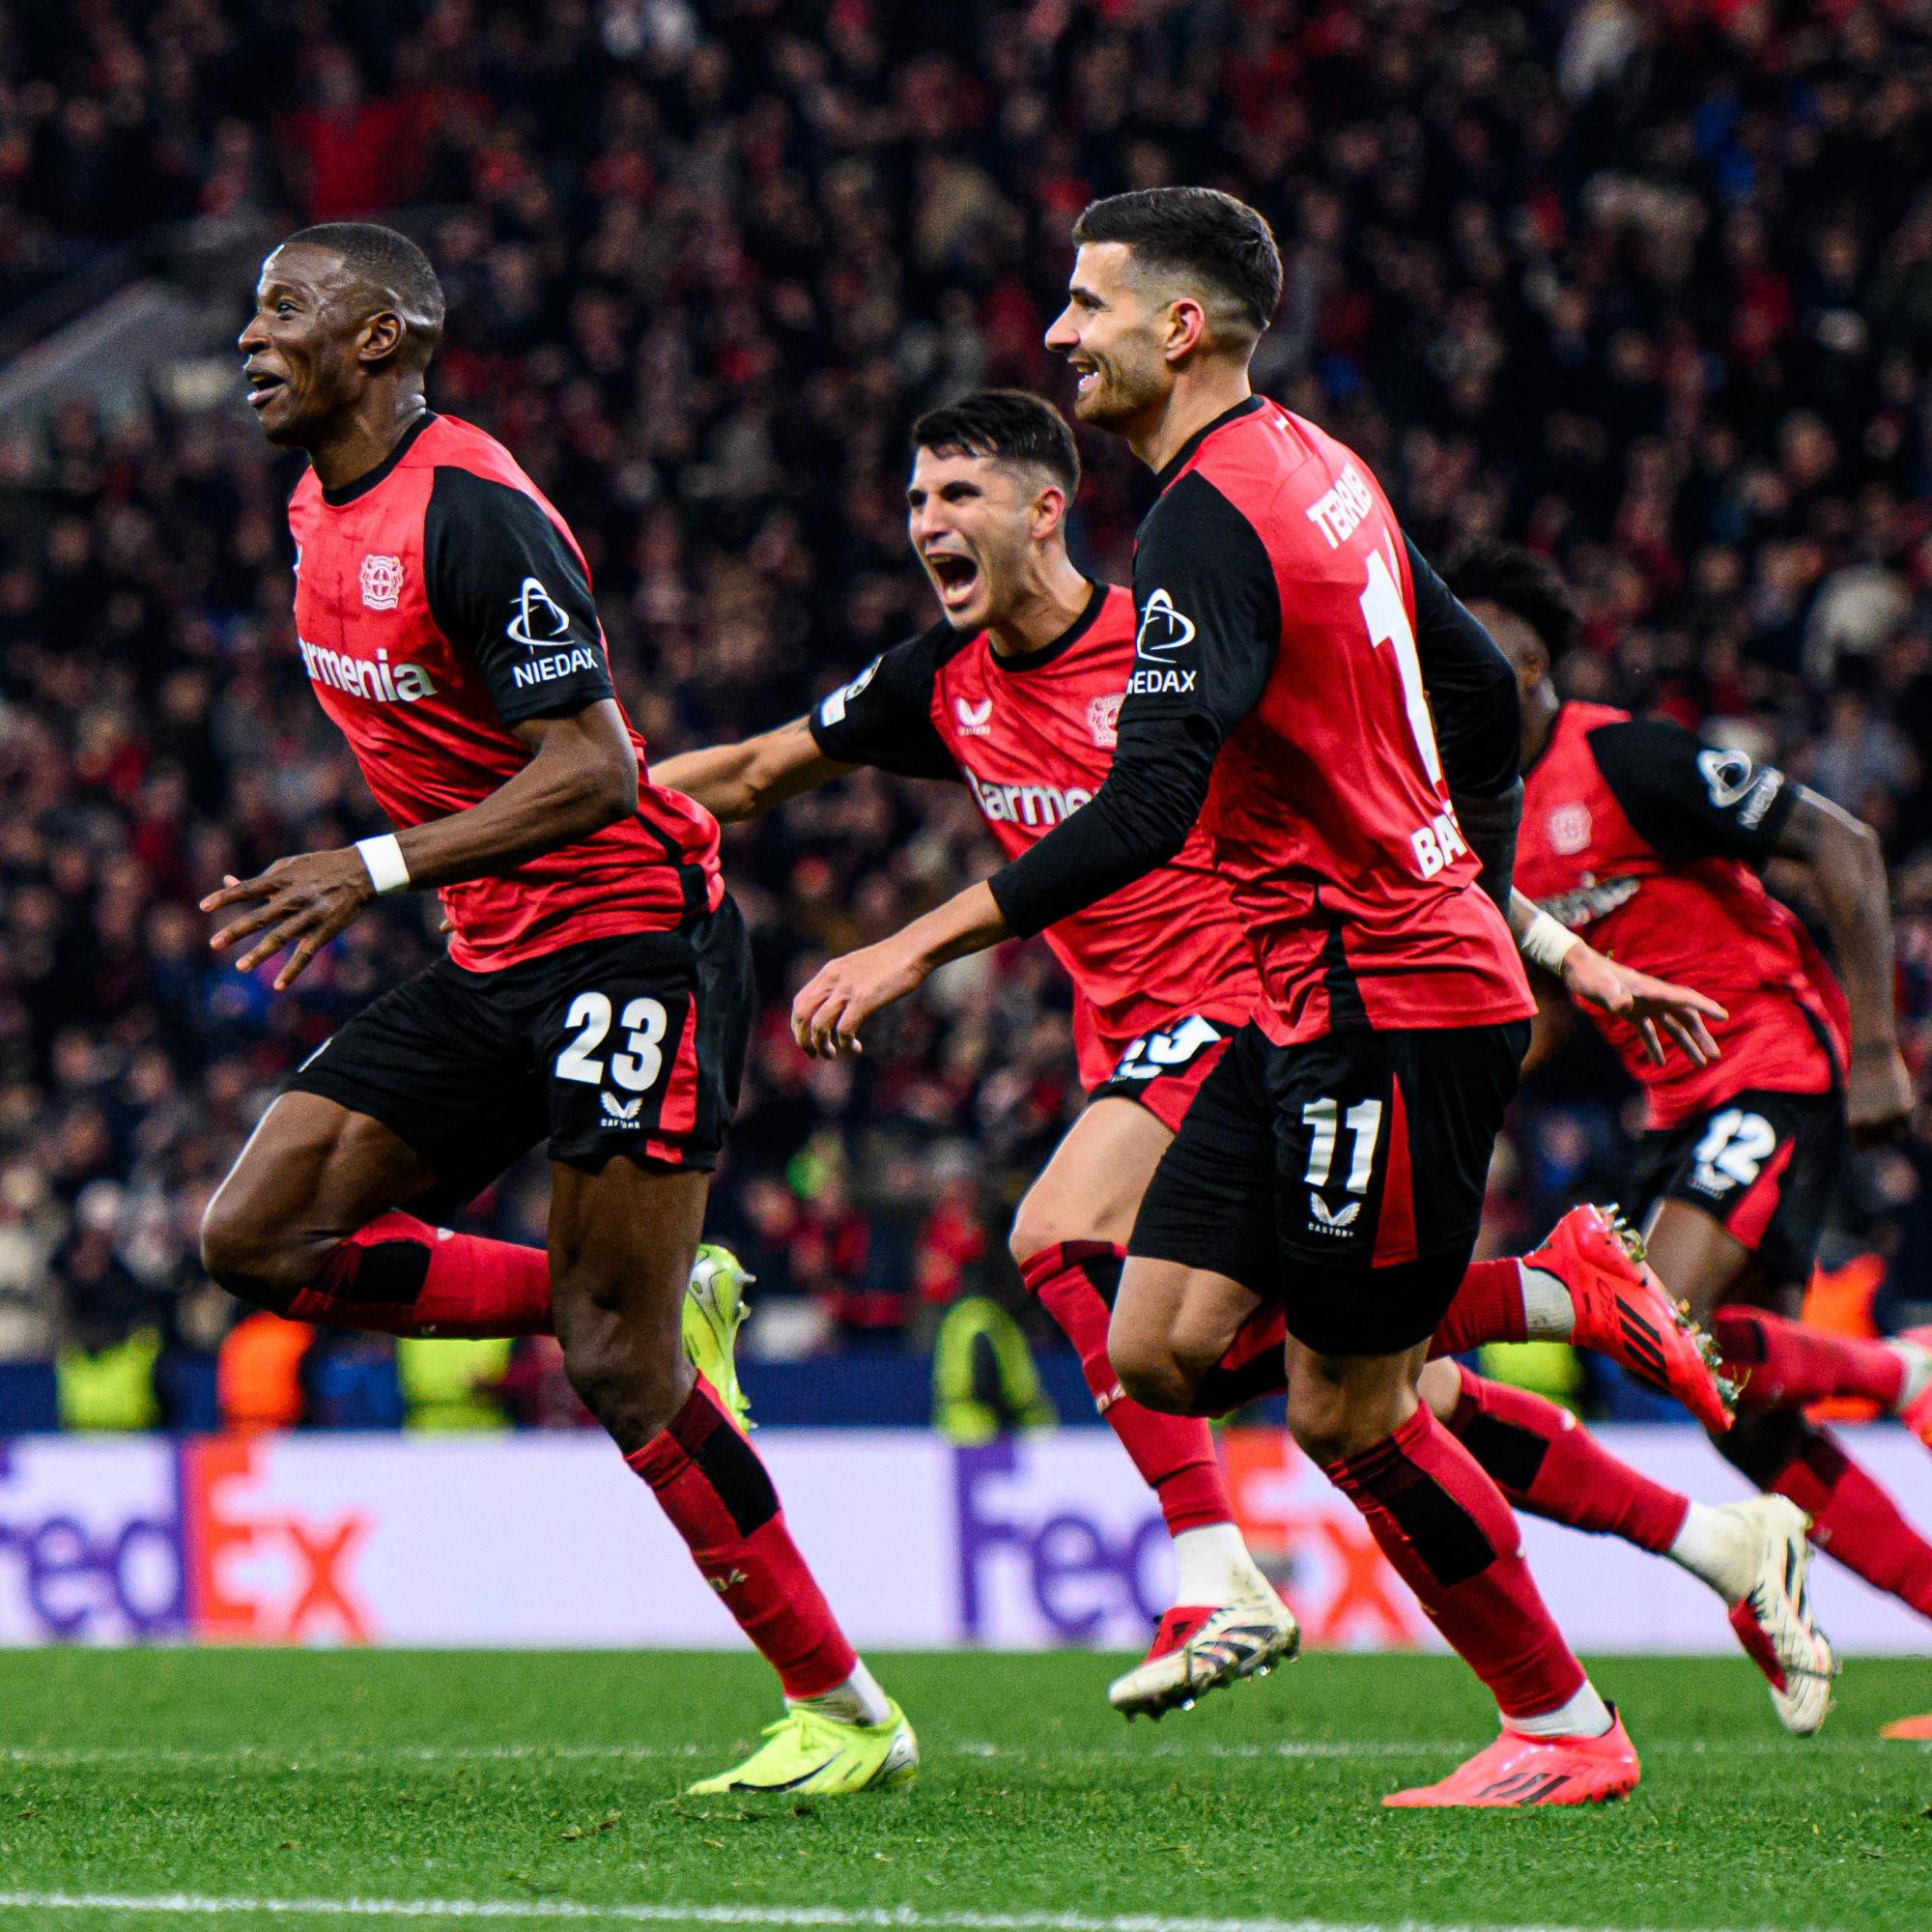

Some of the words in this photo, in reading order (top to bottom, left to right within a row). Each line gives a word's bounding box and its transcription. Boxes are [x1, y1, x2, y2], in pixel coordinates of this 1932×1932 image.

[1305, 462, 1373, 551] TERRIE
[298, 636, 438, 701] rmenia
[513, 647, 598, 688] NIEDAX
[1359, 527, 1443, 786] 1
[963, 765, 1099, 825] arme
[555, 991, 668, 1092] 23
[1303, 1097, 1381, 1194] 11
[0, 1435, 373, 1644] edEx
